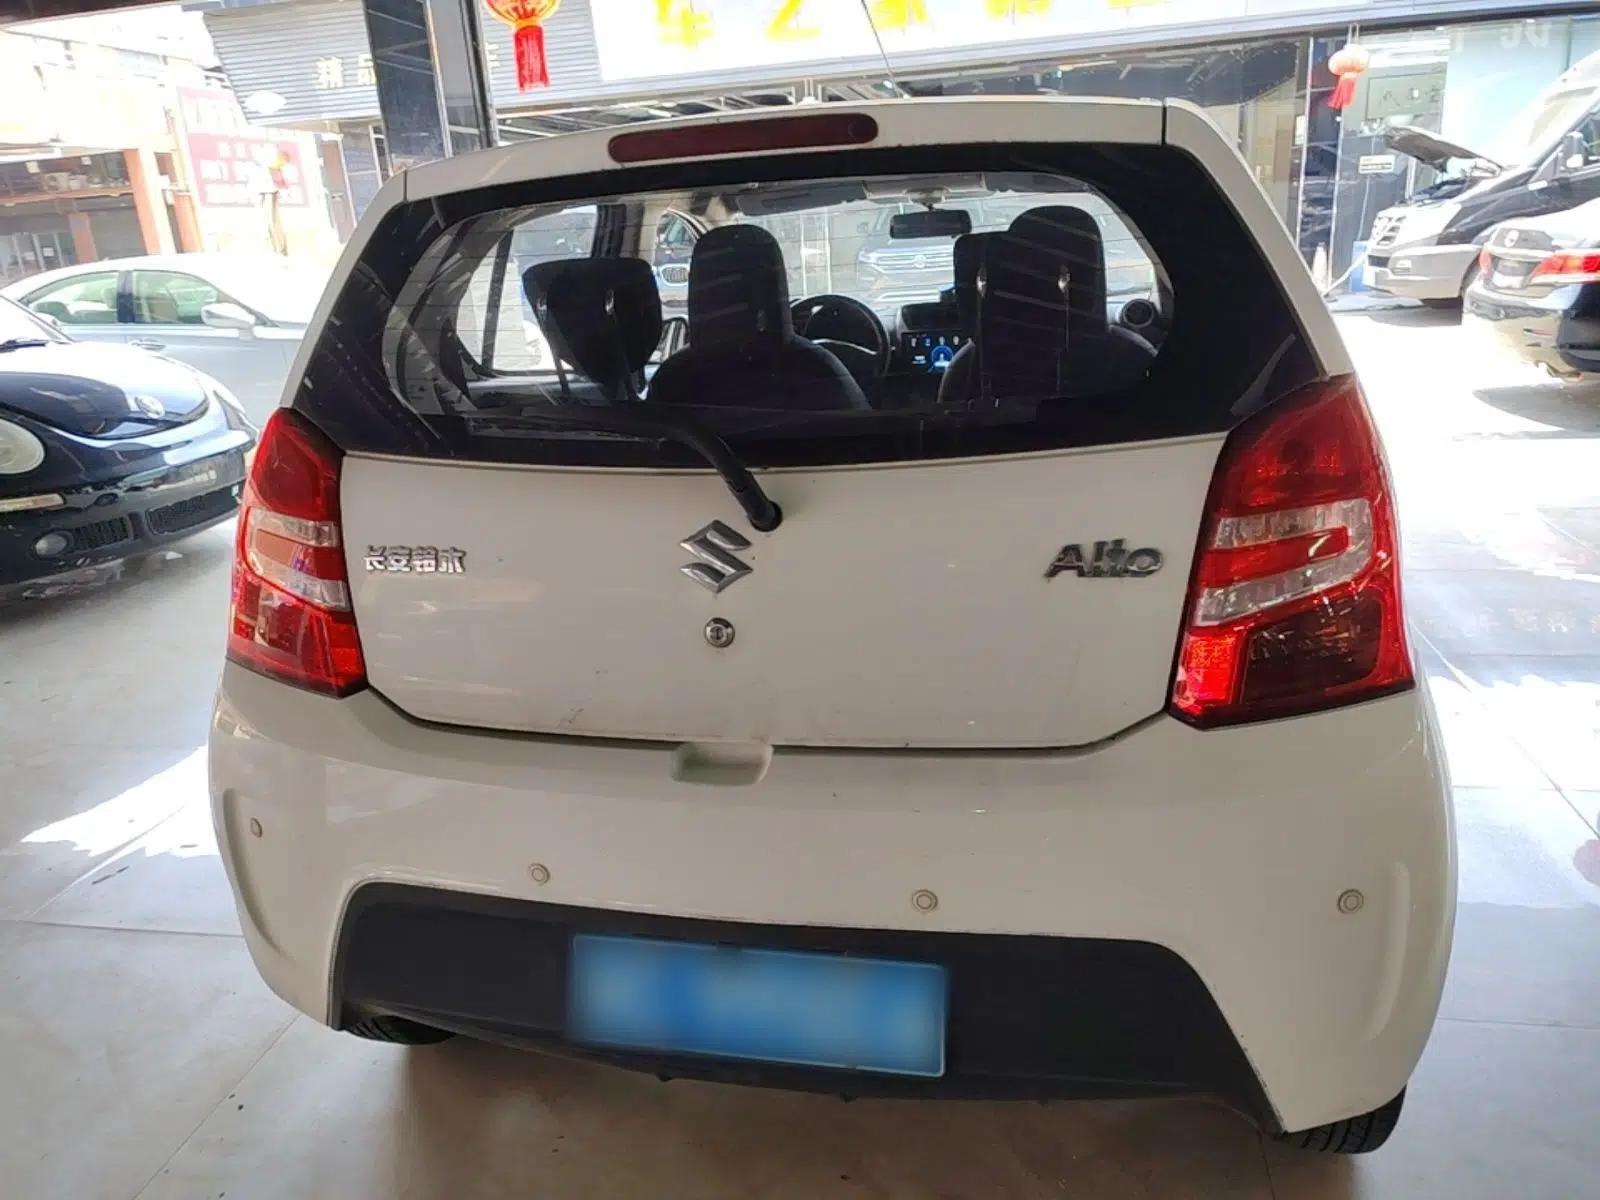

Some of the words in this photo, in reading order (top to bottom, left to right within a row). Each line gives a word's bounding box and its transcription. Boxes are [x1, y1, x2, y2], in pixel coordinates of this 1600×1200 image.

[363, 544, 467, 575] 长安铃木
[1043, 538, 1164, 578] Alto
